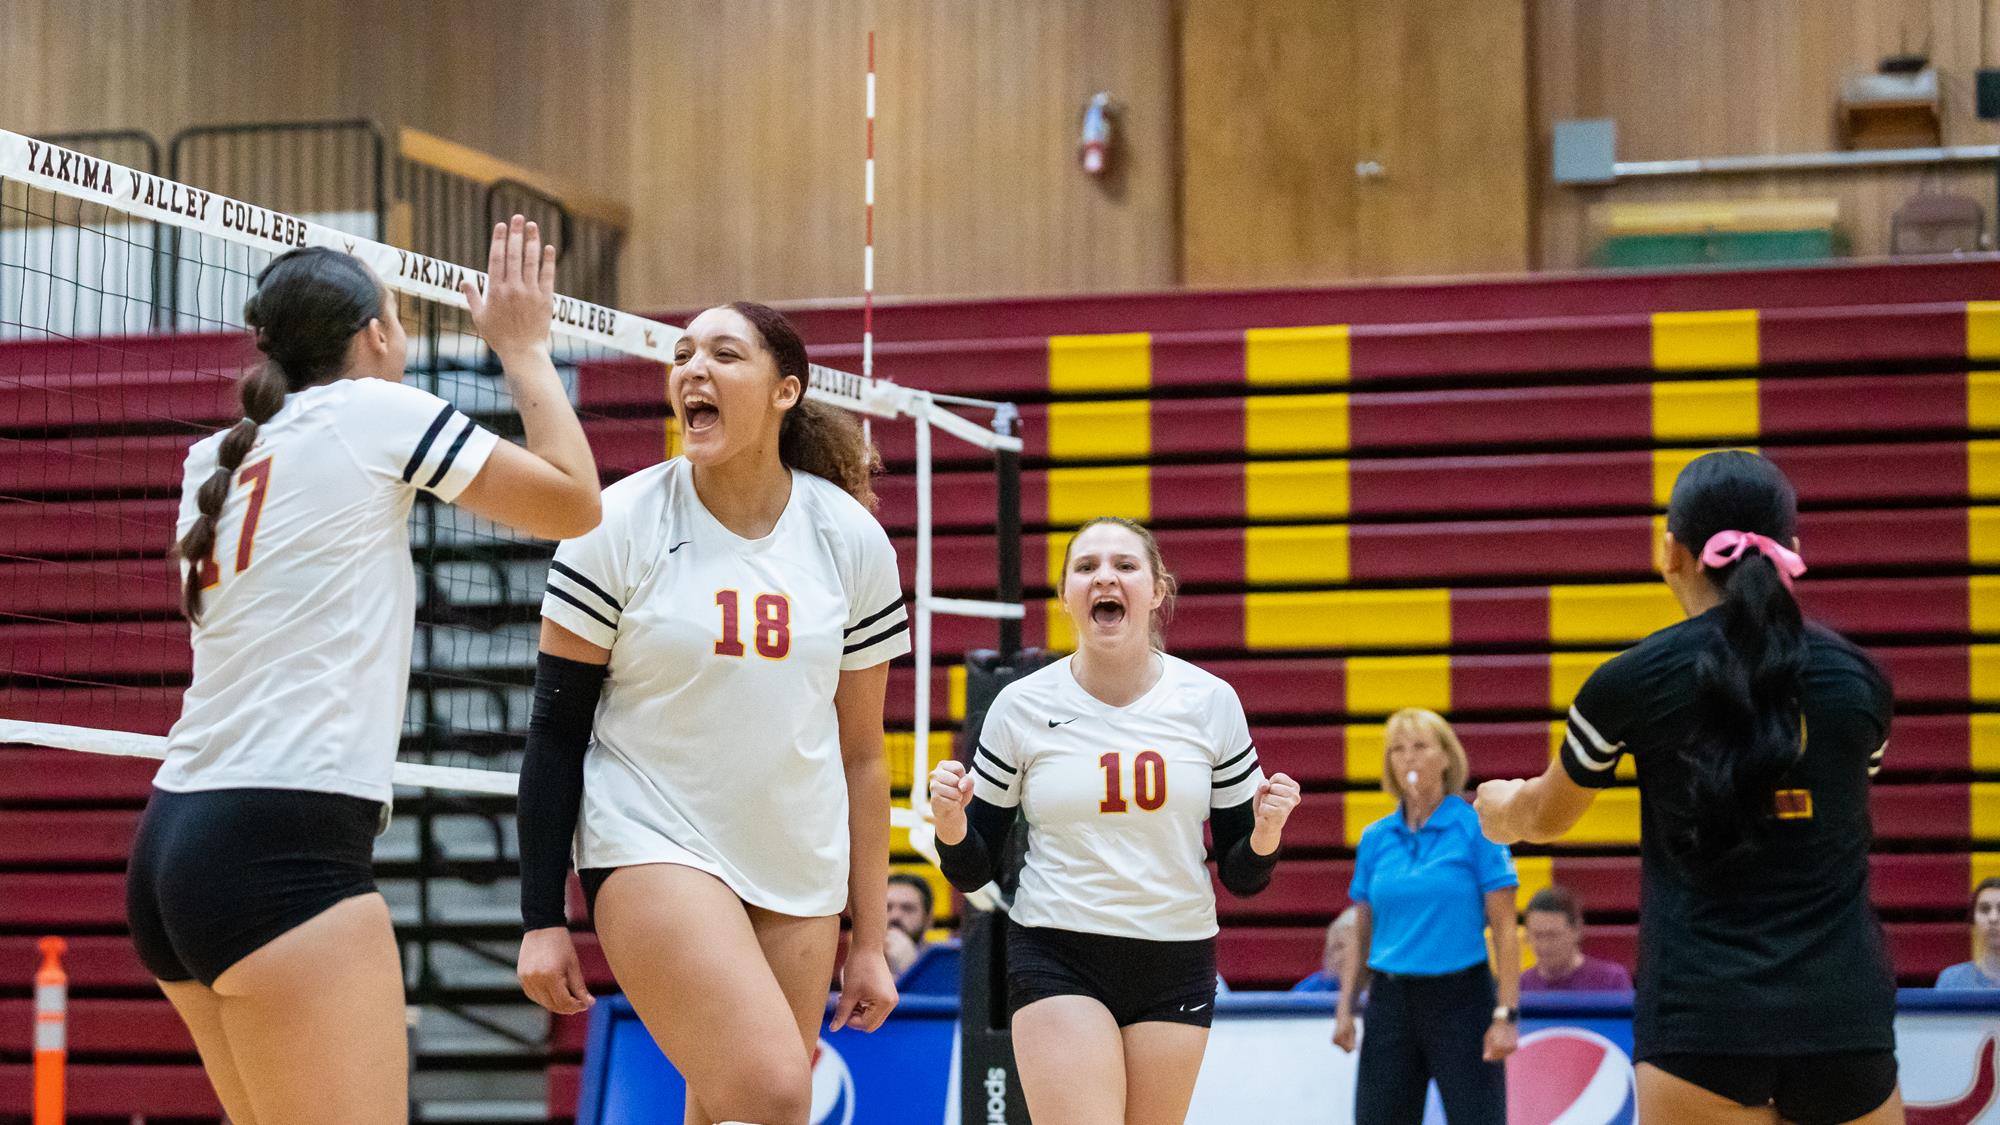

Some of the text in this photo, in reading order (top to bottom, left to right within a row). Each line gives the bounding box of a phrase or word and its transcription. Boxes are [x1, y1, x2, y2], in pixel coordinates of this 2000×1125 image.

[27, 140, 308, 248] YAKIMA VALLEY COLLEGE
[398, 250, 465, 294] YAKIMA
[714, 588, 792, 661] 18
[1099, 749, 1168, 814] 10
[983, 1067, 1007, 1125] spor
